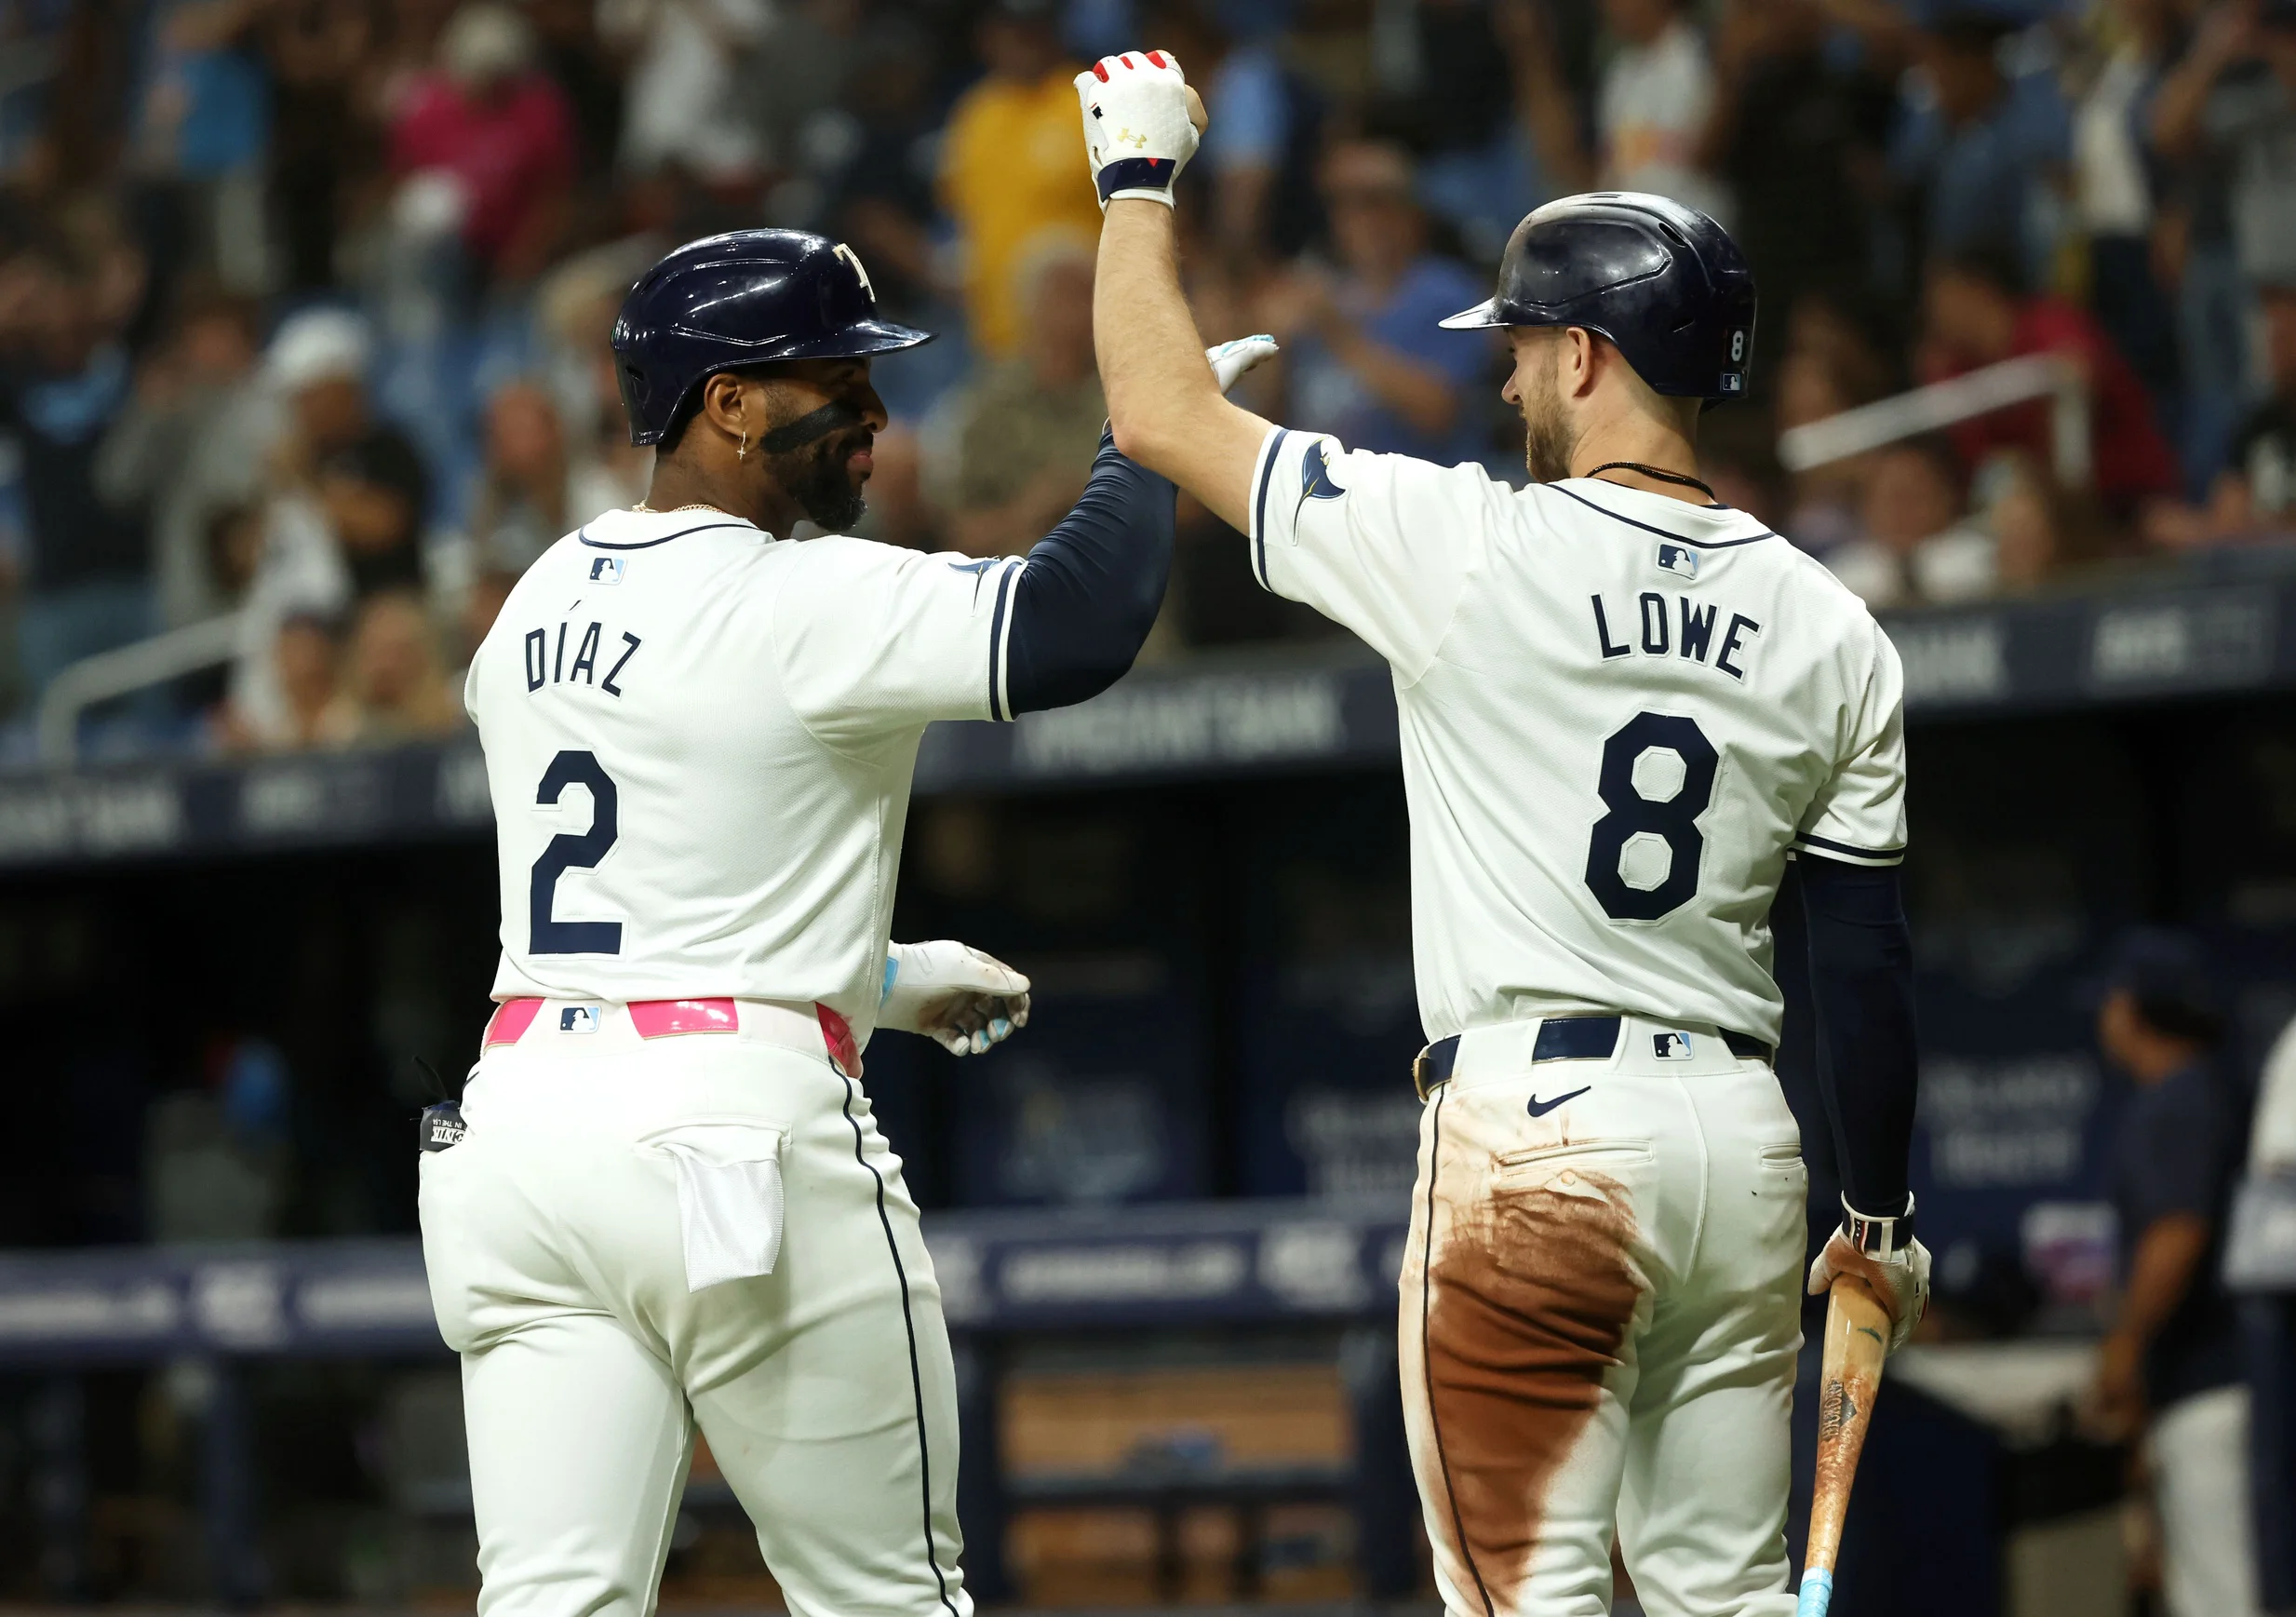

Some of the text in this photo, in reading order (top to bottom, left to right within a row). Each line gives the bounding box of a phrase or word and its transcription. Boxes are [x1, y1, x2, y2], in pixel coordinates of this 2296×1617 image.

[1731, 330, 1744, 361] 8
[524, 600, 642, 698] DÍAZ
[1591, 592, 1760, 680] LOWE
[528, 749, 623, 955] 2
[1584, 710, 1720, 921] 8
